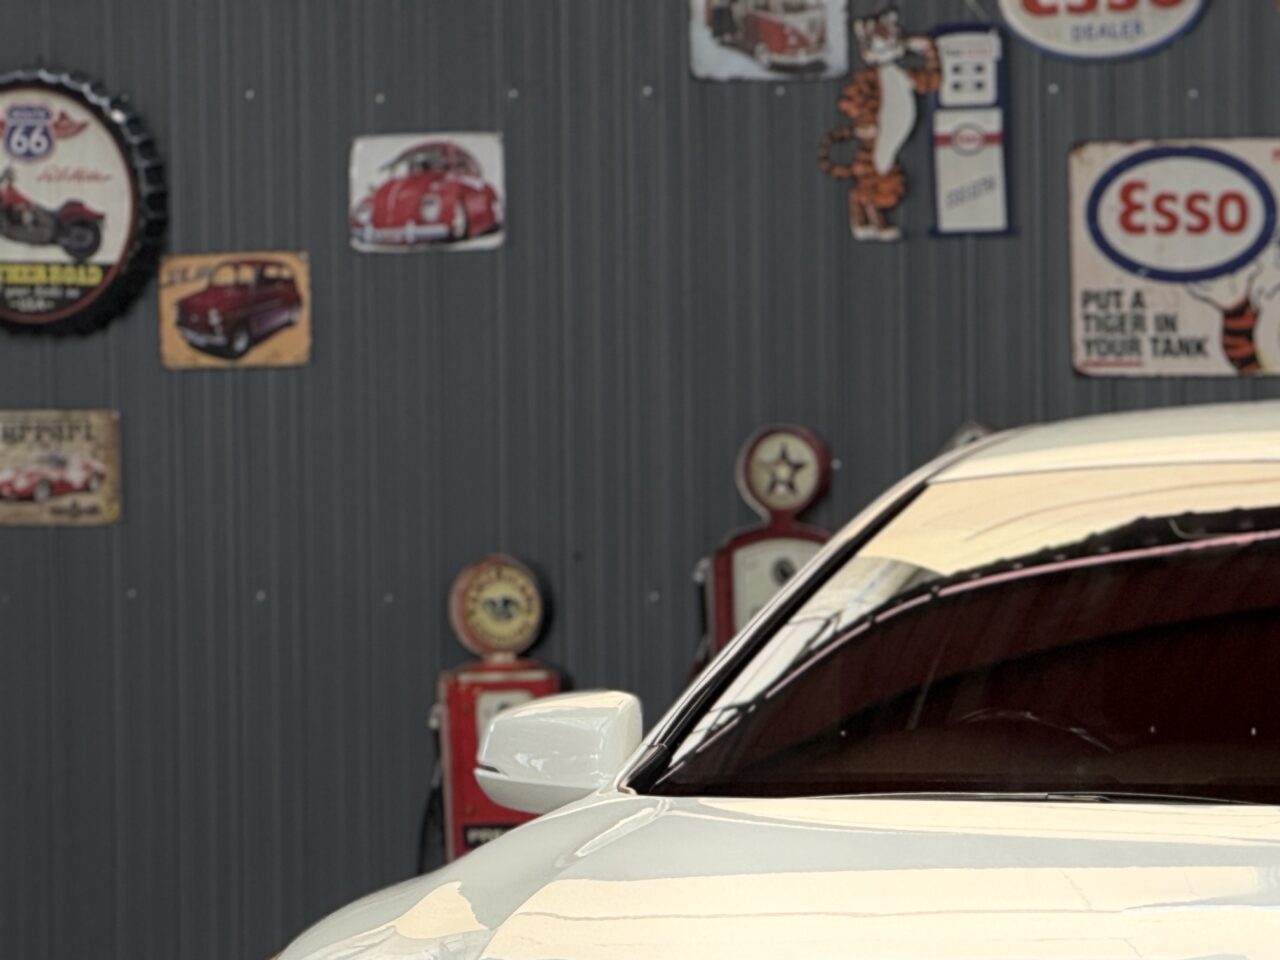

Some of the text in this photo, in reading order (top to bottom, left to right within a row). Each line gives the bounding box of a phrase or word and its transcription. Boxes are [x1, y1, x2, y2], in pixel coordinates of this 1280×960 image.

[1071, 20, 1143, 42] DEALER
[9, 126, 49, 156] 66
[1081, 290, 1146, 310] PUT A
[1082, 314, 1179, 334] TIGER IN
[1081, 337, 1209, 358] YOUR TANK
